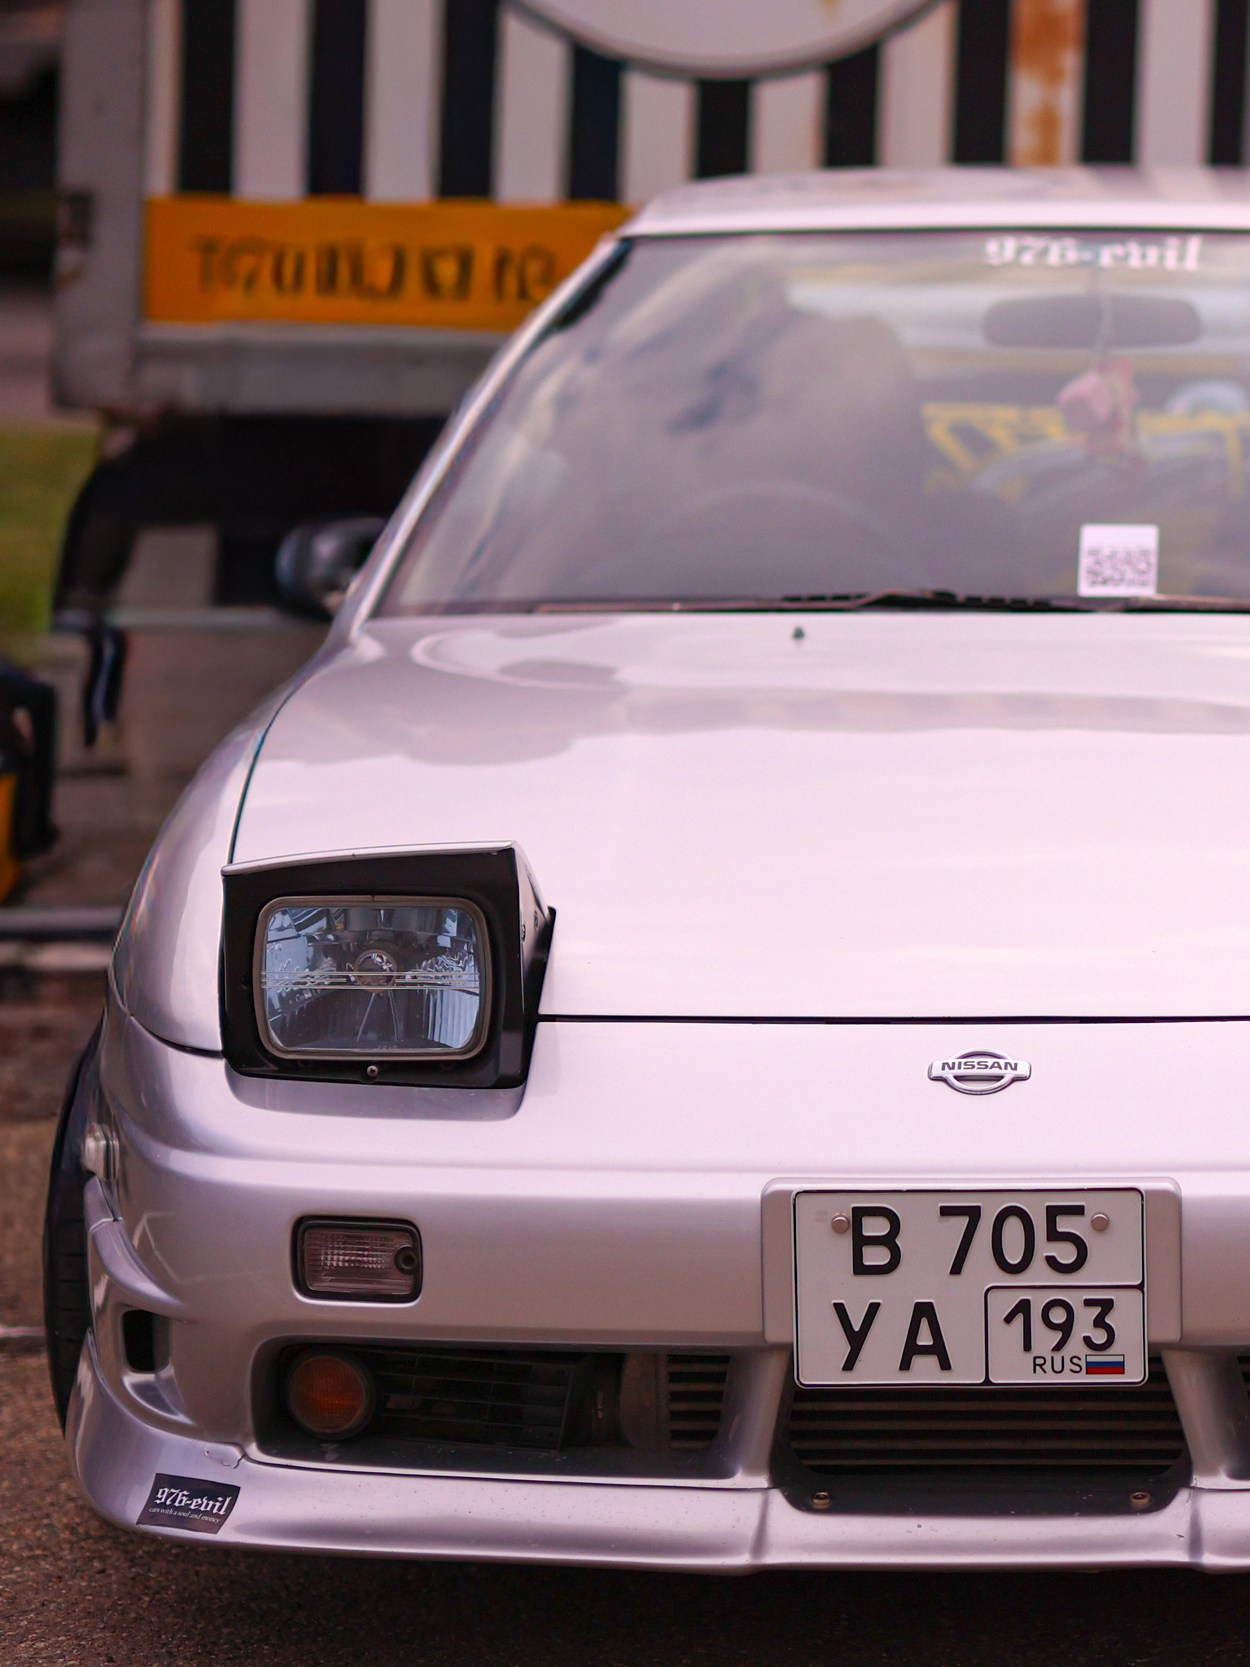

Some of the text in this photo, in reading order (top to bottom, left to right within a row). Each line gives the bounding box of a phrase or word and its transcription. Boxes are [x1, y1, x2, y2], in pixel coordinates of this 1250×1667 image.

[941, 1061, 1018, 1071] NISSAN
[939, 1204, 1088, 1275] 705
[1003, 1298, 1116, 1352] 193
[1032, 1355, 1083, 1374] RUS
[154, 1487, 231, 1515] 976-evil
